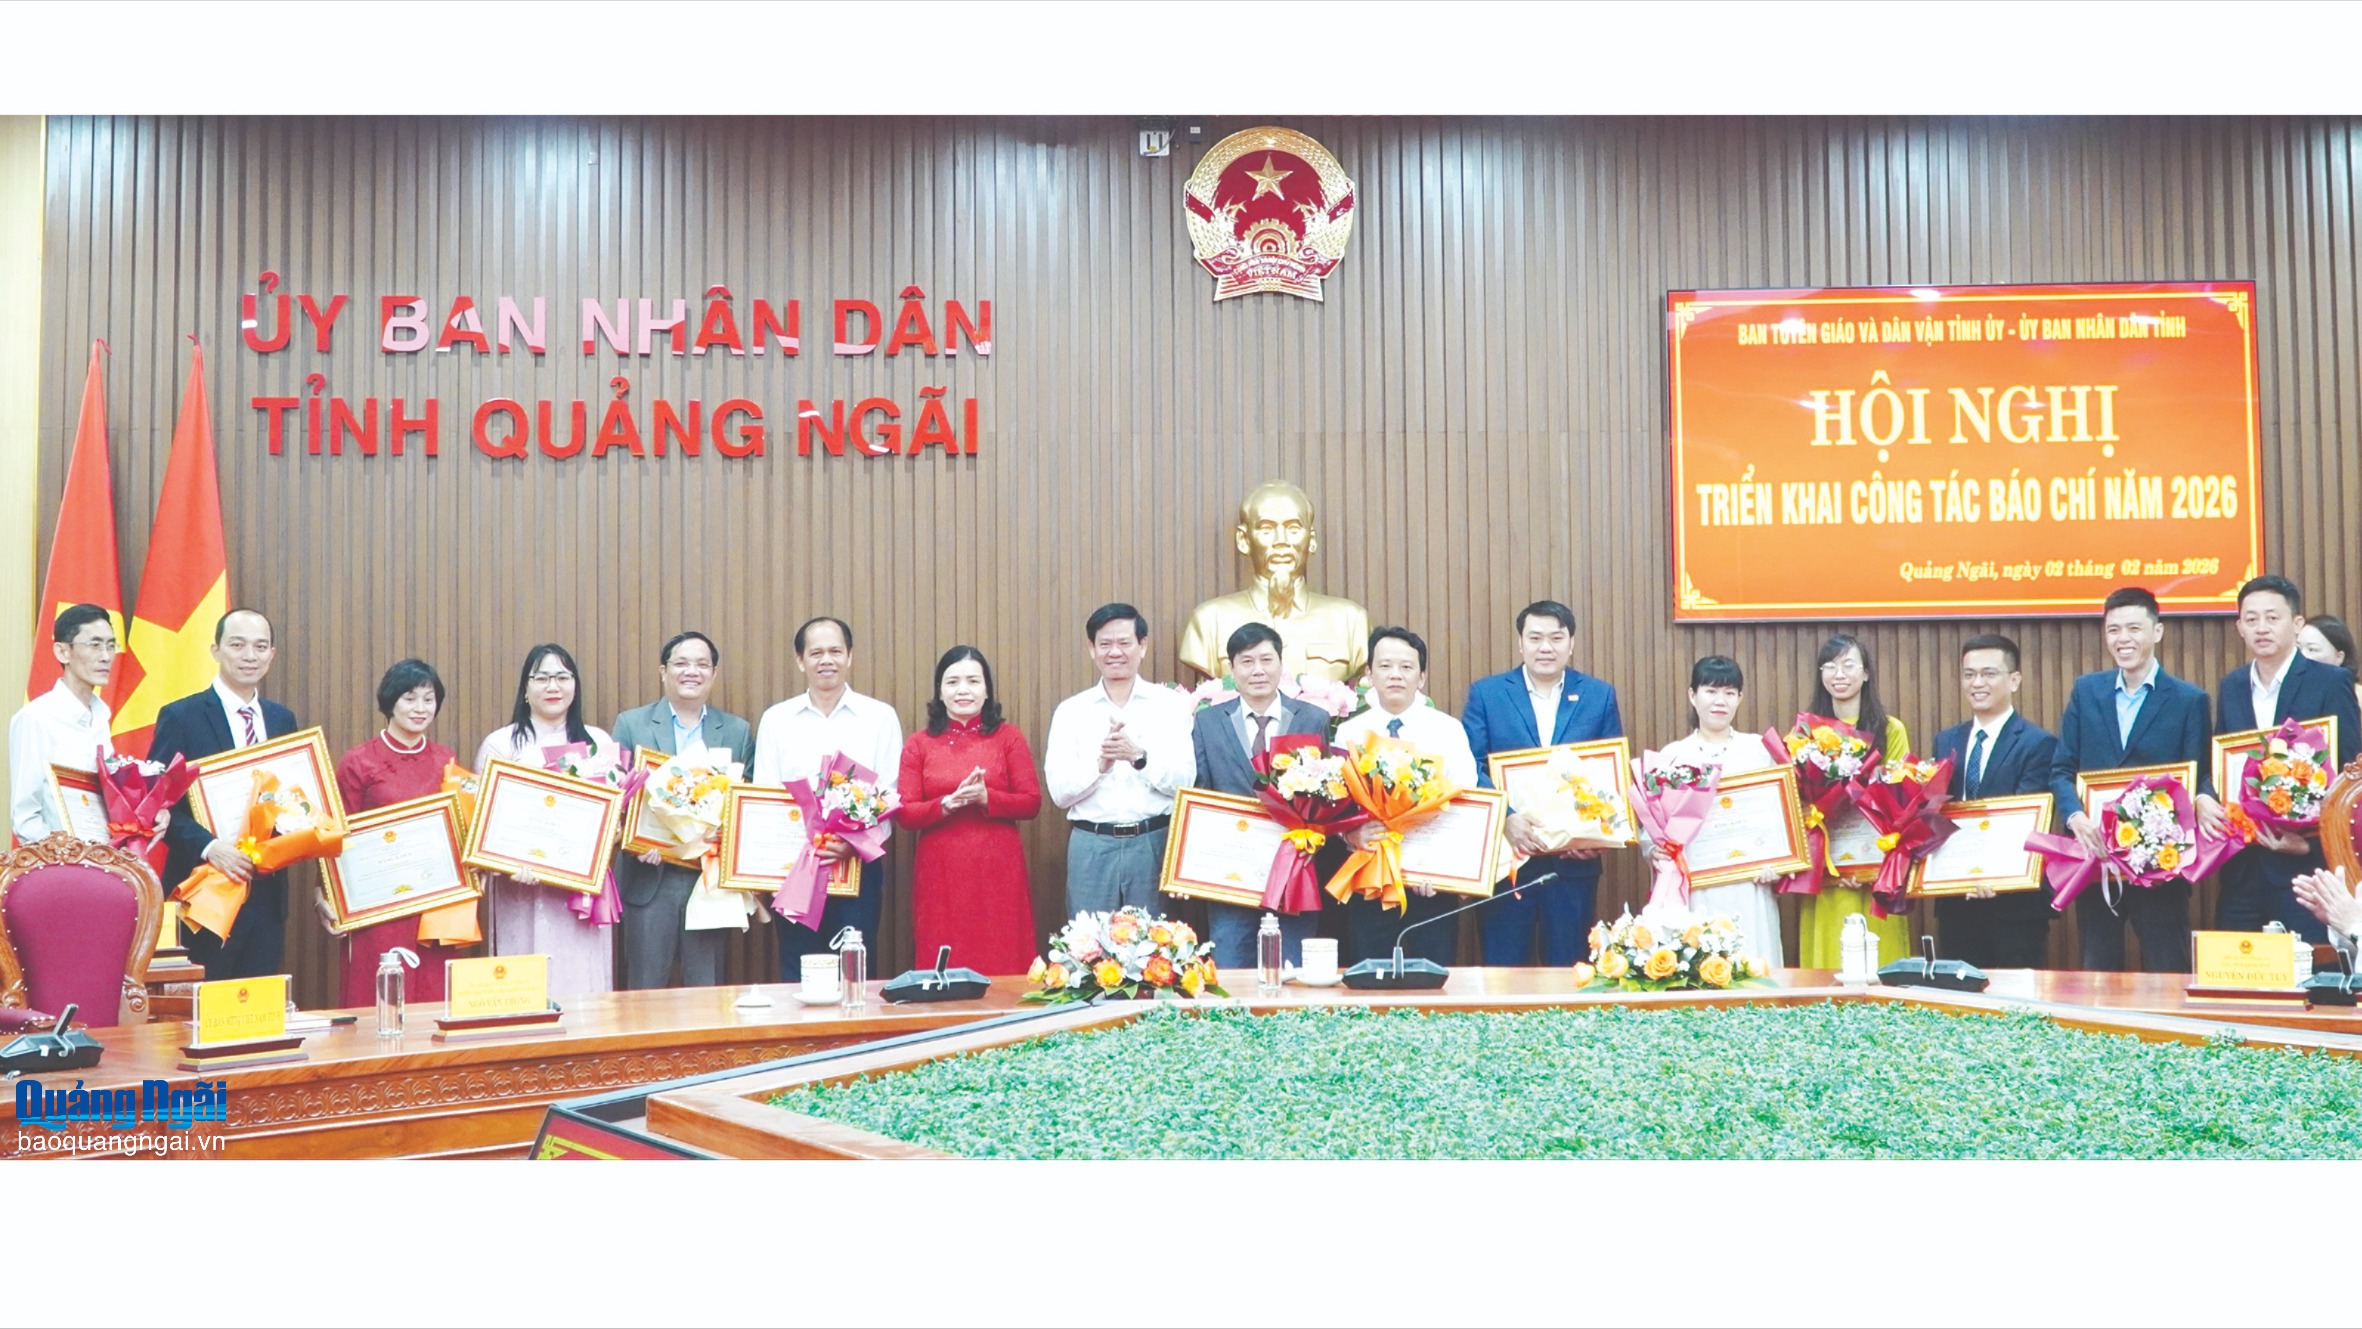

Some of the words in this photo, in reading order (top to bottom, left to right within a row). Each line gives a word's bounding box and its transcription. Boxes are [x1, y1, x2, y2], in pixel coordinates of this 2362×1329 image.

[241, 271, 350, 353] ỦY
[380, 296, 546, 355] BAN
[582, 284, 800, 356] NHÂN
[833, 285, 991, 356] DÂN
[1738, 323, 1767, 345] BAN
[1820, 317, 1855, 344] GIÁO
[1858, 317, 1878, 343] VÀ
[1882, 316, 1911, 343] DÂN
[1915, 315, 1944, 347] VẬN
[1947, 314, 1981, 342] TỈNH
[1985, 313, 2004, 341] ỦY
[2019, 312, 2039, 341] ỦY
[2042, 318, 2071, 340] BAN
[2075, 312, 2115, 339] NHÂN
[2119, 312, 2149, 339] DÂN
[2153, 310, 2186, 338] TỈNH
[251, 373, 438, 456] TỈNH
[472, 376, 764, 459] QUẢNG
[799, 385, 978, 457] NGÃI
[1810, 370, 1931, 463] HỘI
[1949, 384, 2120, 458] NGHỊ
[1696, 464, 1772, 526] TRIỂN
[1782, 480, 1842, 525] KHAI
[1851, 470, 1922, 524] CÔNG
[1929, 468, 1981, 523] TÁC
[1989, 468, 2042, 522] BÁO
[2049, 467, 2096, 521] CHÍ
[2103, 468, 2163, 520] NĂM
[2170, 474, 2238, 519] 2026
[1899, 560, 1954, 582] Quảng
[1956, 561, 1999, 581] Ngãi,
[2002, 562, 2042, 581] ngày
[2044, 560, 2063, 577] 02
[2067, 560, 2115, 580] tháng
[2120, 559, 2141, 576] 02
[2143, 560, 2179, 576] năm
[2181, 558, 2220, 575] 2026
